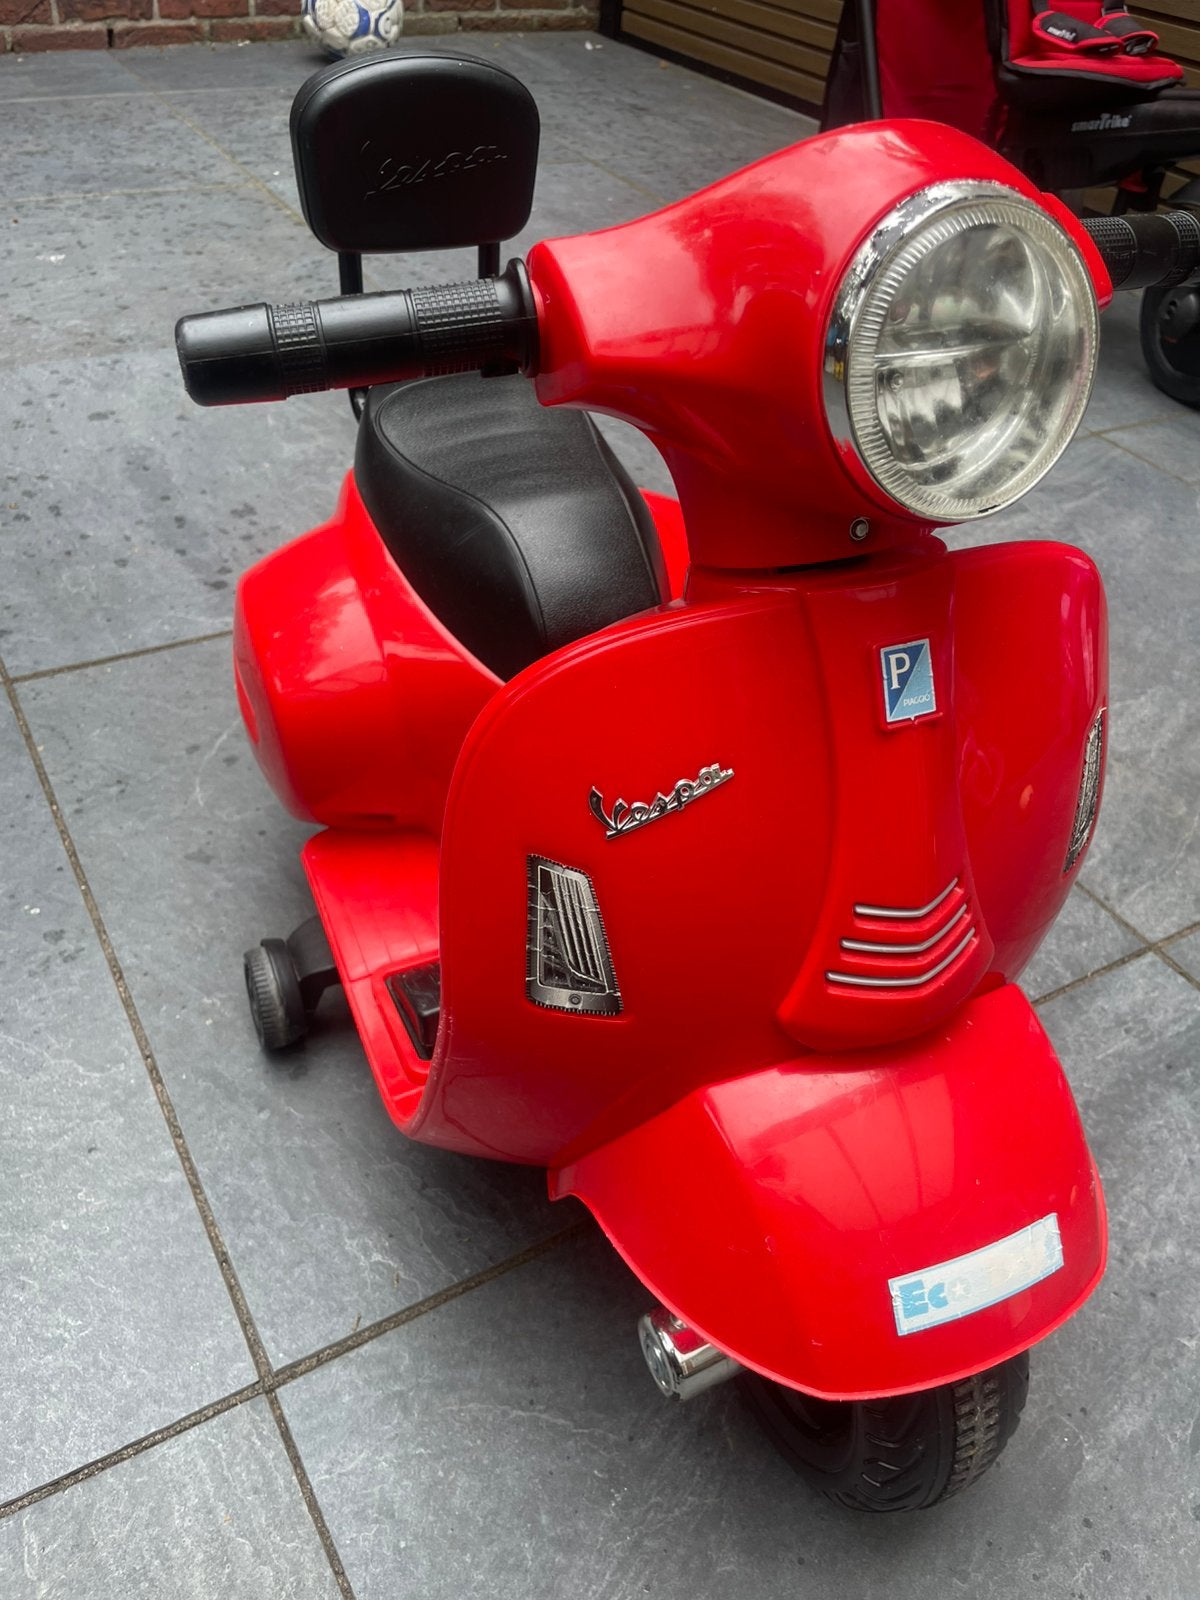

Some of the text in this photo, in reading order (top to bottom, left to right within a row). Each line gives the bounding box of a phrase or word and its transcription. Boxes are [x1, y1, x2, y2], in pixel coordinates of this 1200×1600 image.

[888, 652, 911, 690] P
[903, 693, 931, 707] PIAGGIO
[588, 762, 735, 840] Vespa
